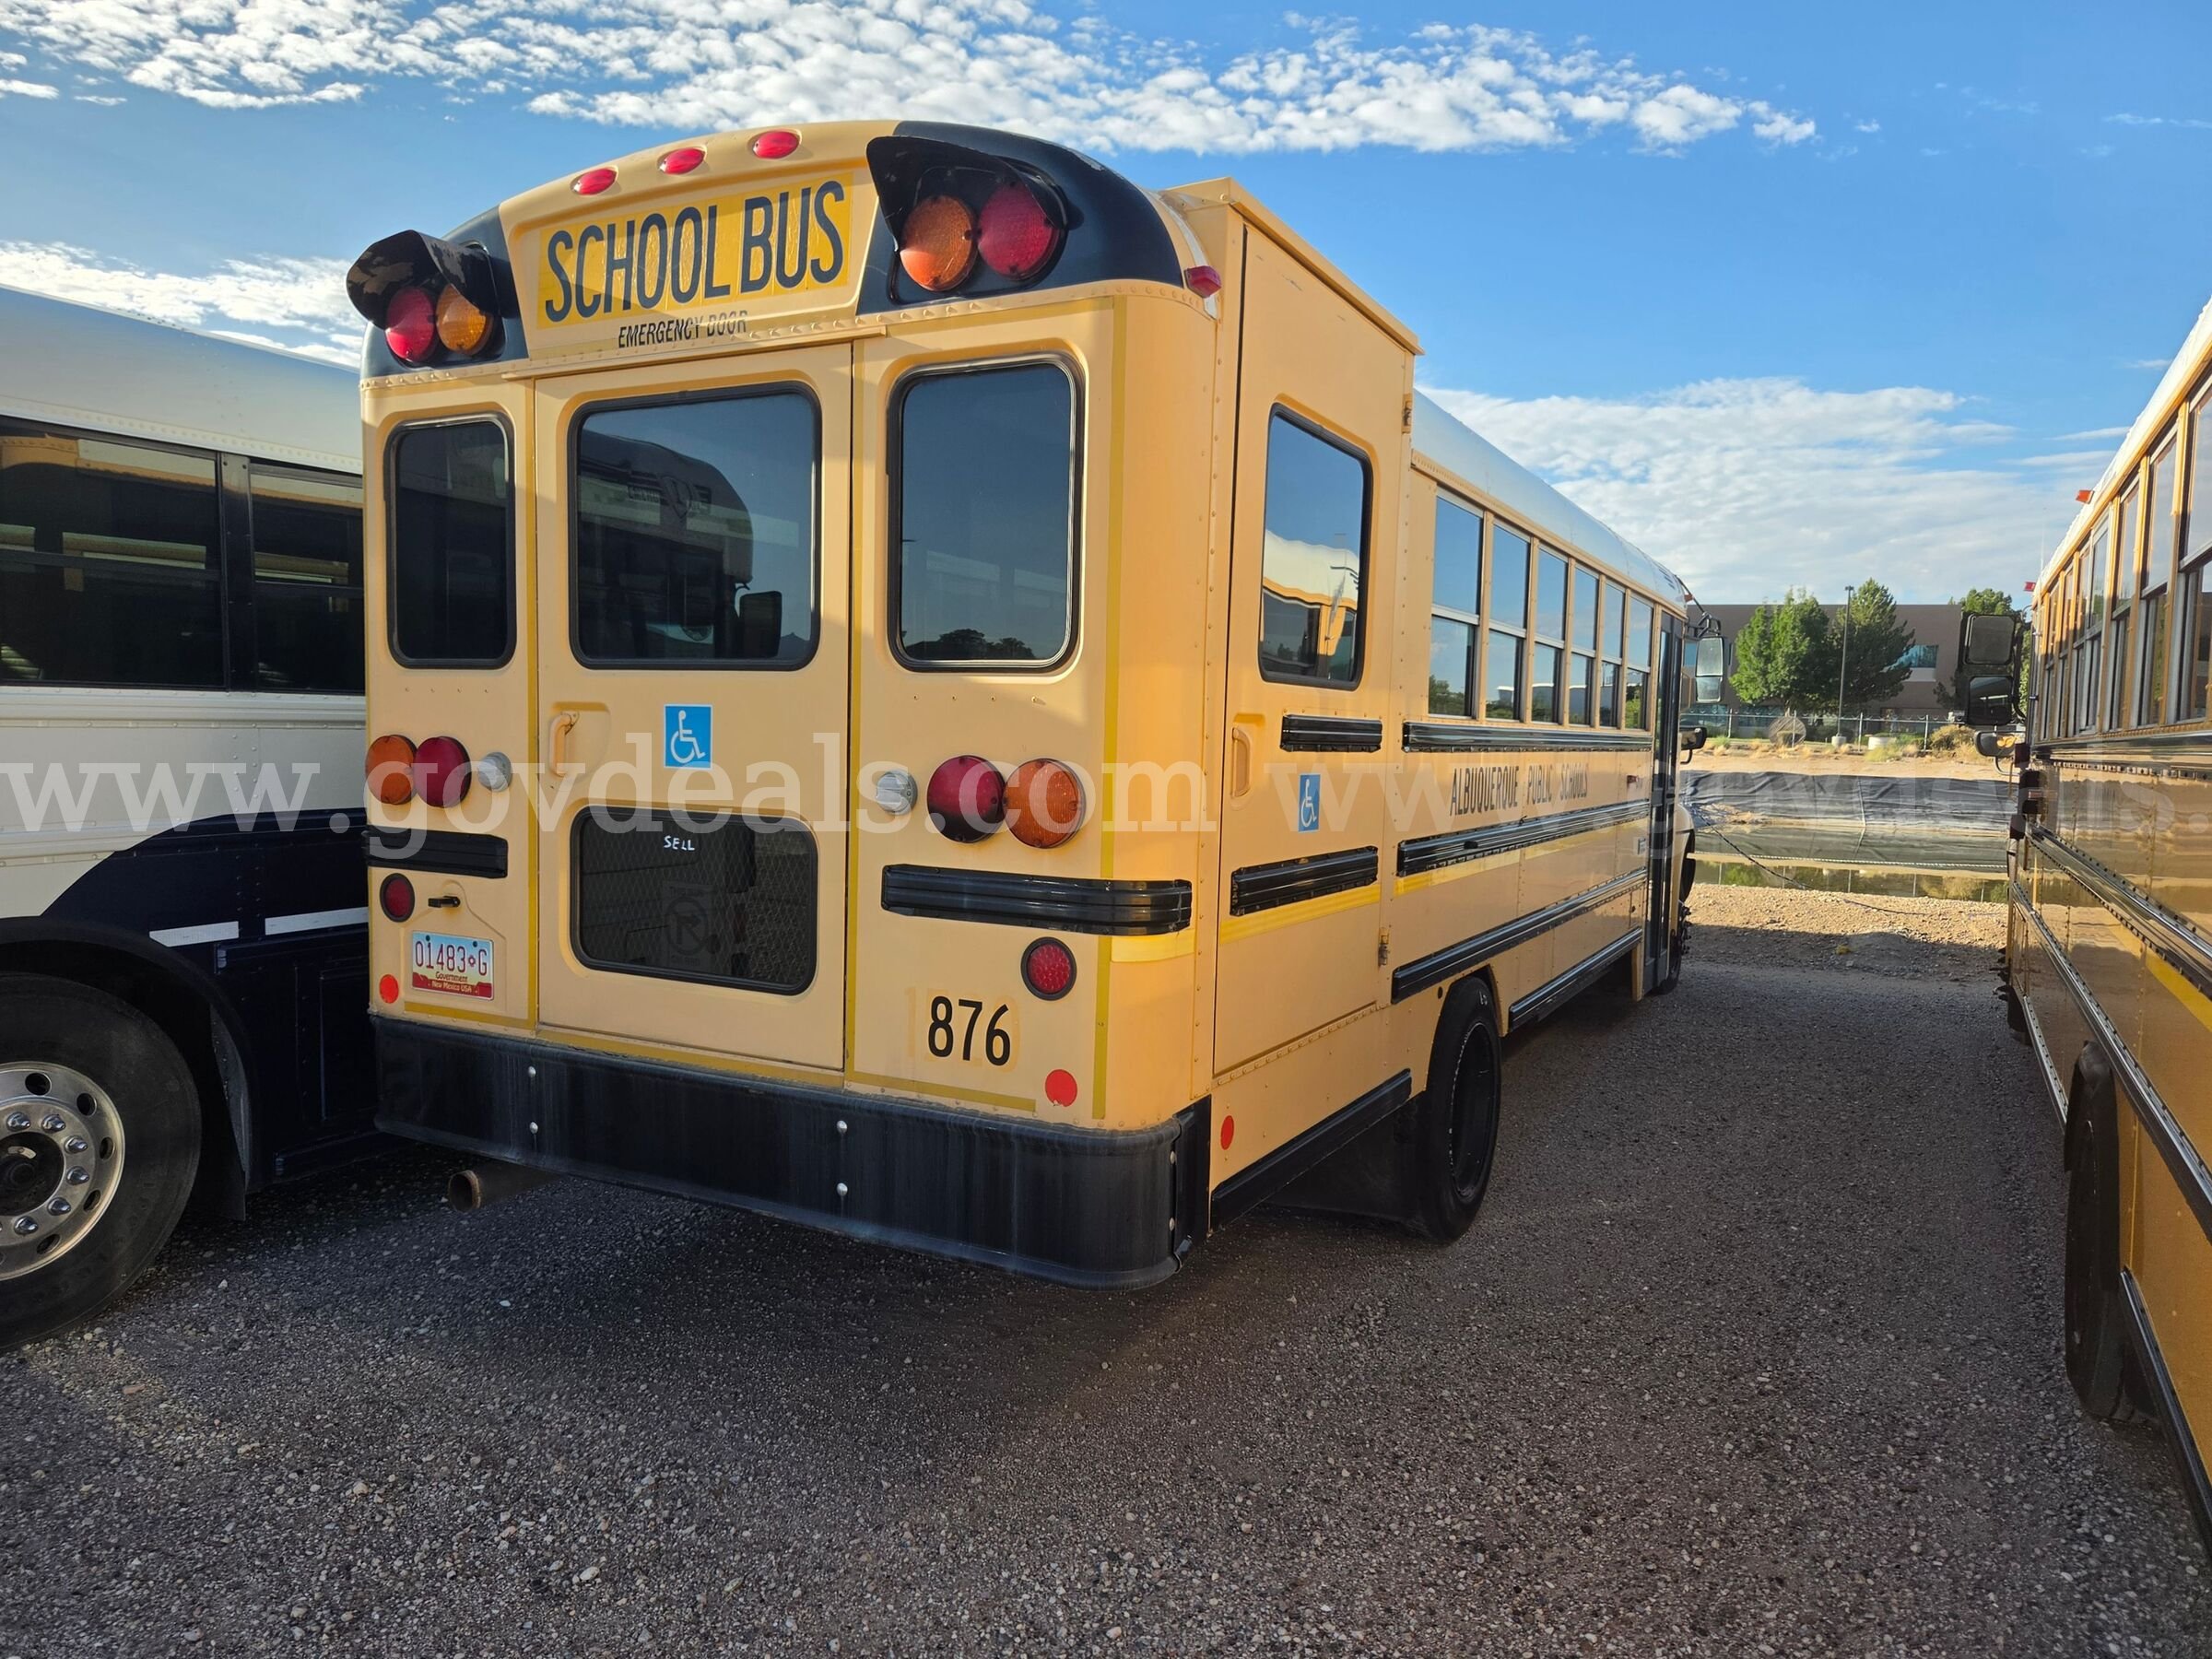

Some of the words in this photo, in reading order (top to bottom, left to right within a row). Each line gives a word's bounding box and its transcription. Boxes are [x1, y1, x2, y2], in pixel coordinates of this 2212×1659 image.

[545, 205, 731, 323] SCHOOL
[740, 180, 845, 294] BUS
[618, 315, 703, 348] EMERGENCY
[707, 310, 748, 337] DOOR
[1450, 765, 1520, 817] ALBUQUERQUE
[1526, 764, 1553, 806] PUBLIC
[1559, 761, 1589, 800] SCHOOLS
[664, 835, 696, 851] SELL
[432, 980, 442, 989] New
[443, 981, 460, 991] Mexico
[461, 983, 473, 993] USA
[435, 971, 468, 982] Government
[927, 995, 1011, 1066] 876
